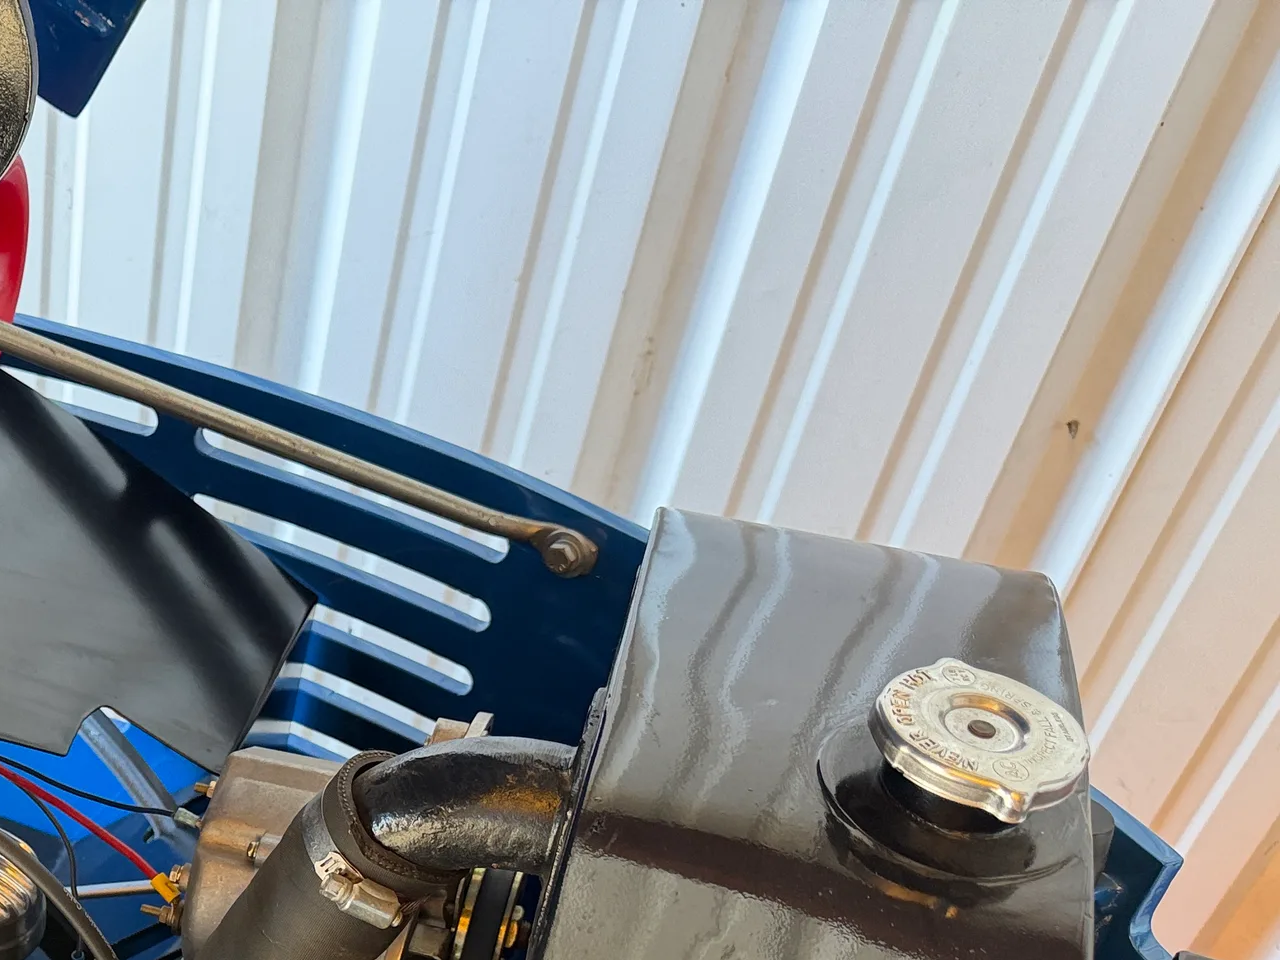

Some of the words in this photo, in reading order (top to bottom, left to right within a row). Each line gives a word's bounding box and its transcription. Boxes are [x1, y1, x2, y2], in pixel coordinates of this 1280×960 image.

[899, 669, 932, 690] HOT
[890, 689, 915, 725] OPEN
[980, 682, 1032, 708] SPRING
[1039, 716, 1057, 739] FALL
[909, 730, 979, 771] NEVER
